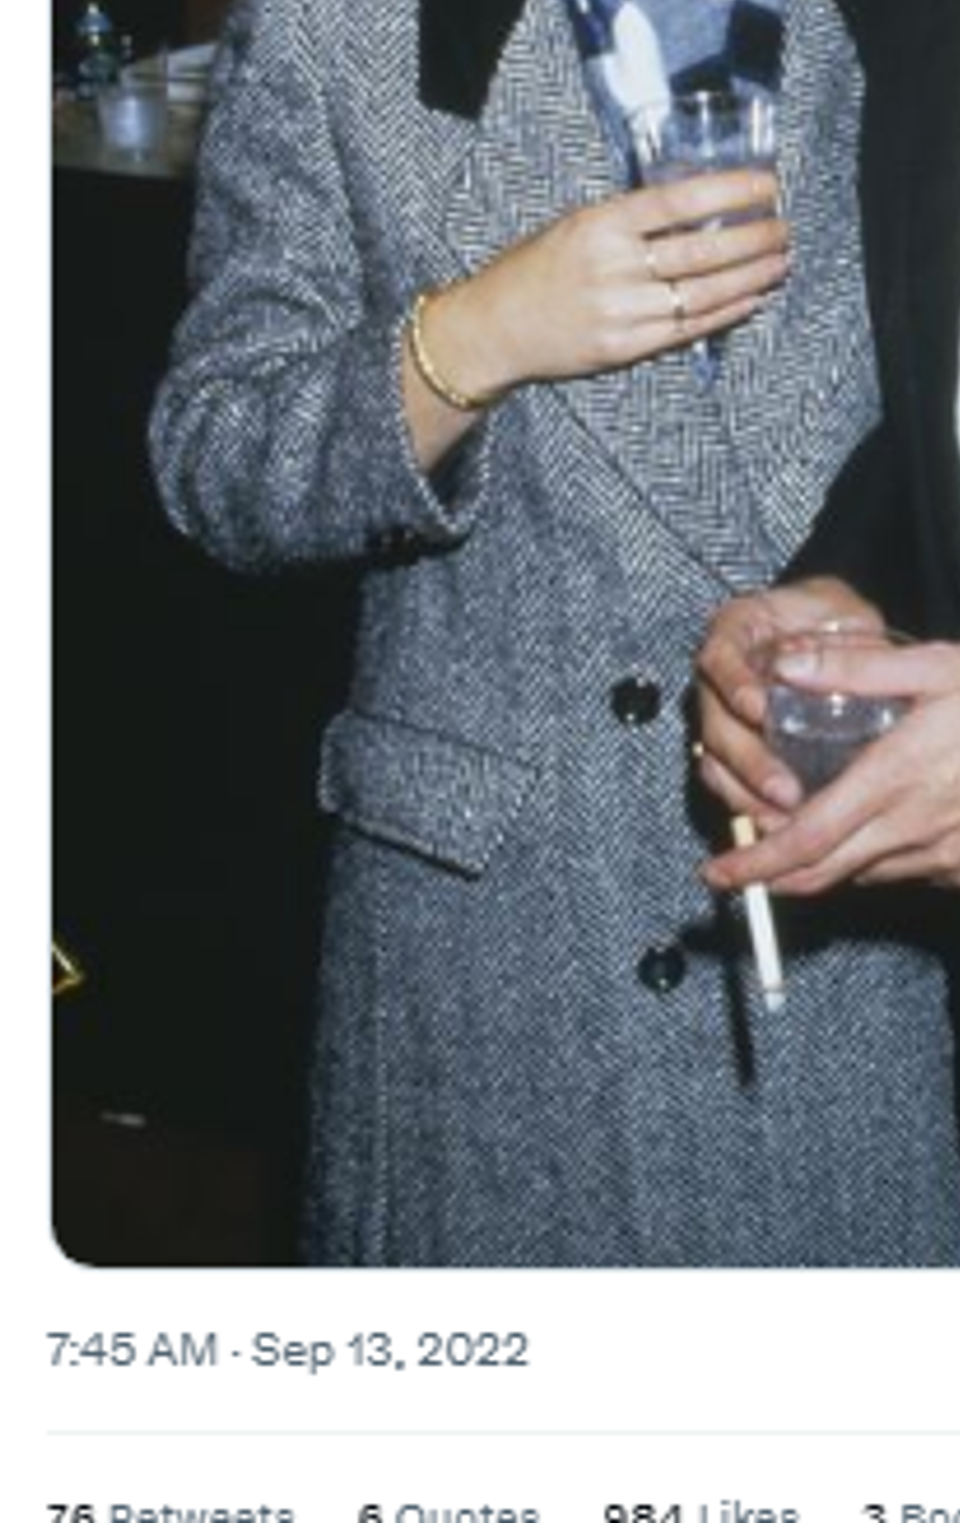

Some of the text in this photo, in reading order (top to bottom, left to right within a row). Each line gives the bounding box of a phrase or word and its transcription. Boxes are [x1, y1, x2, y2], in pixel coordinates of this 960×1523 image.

[47, 1331, 136, 1366] 7:45
[147, 1331, 216, 1366] AM
[252, 1331, 335, 1374] Sep
[348, 1331, 405, 1371] 13,
[418, 1331, 529, 1366] 2022
